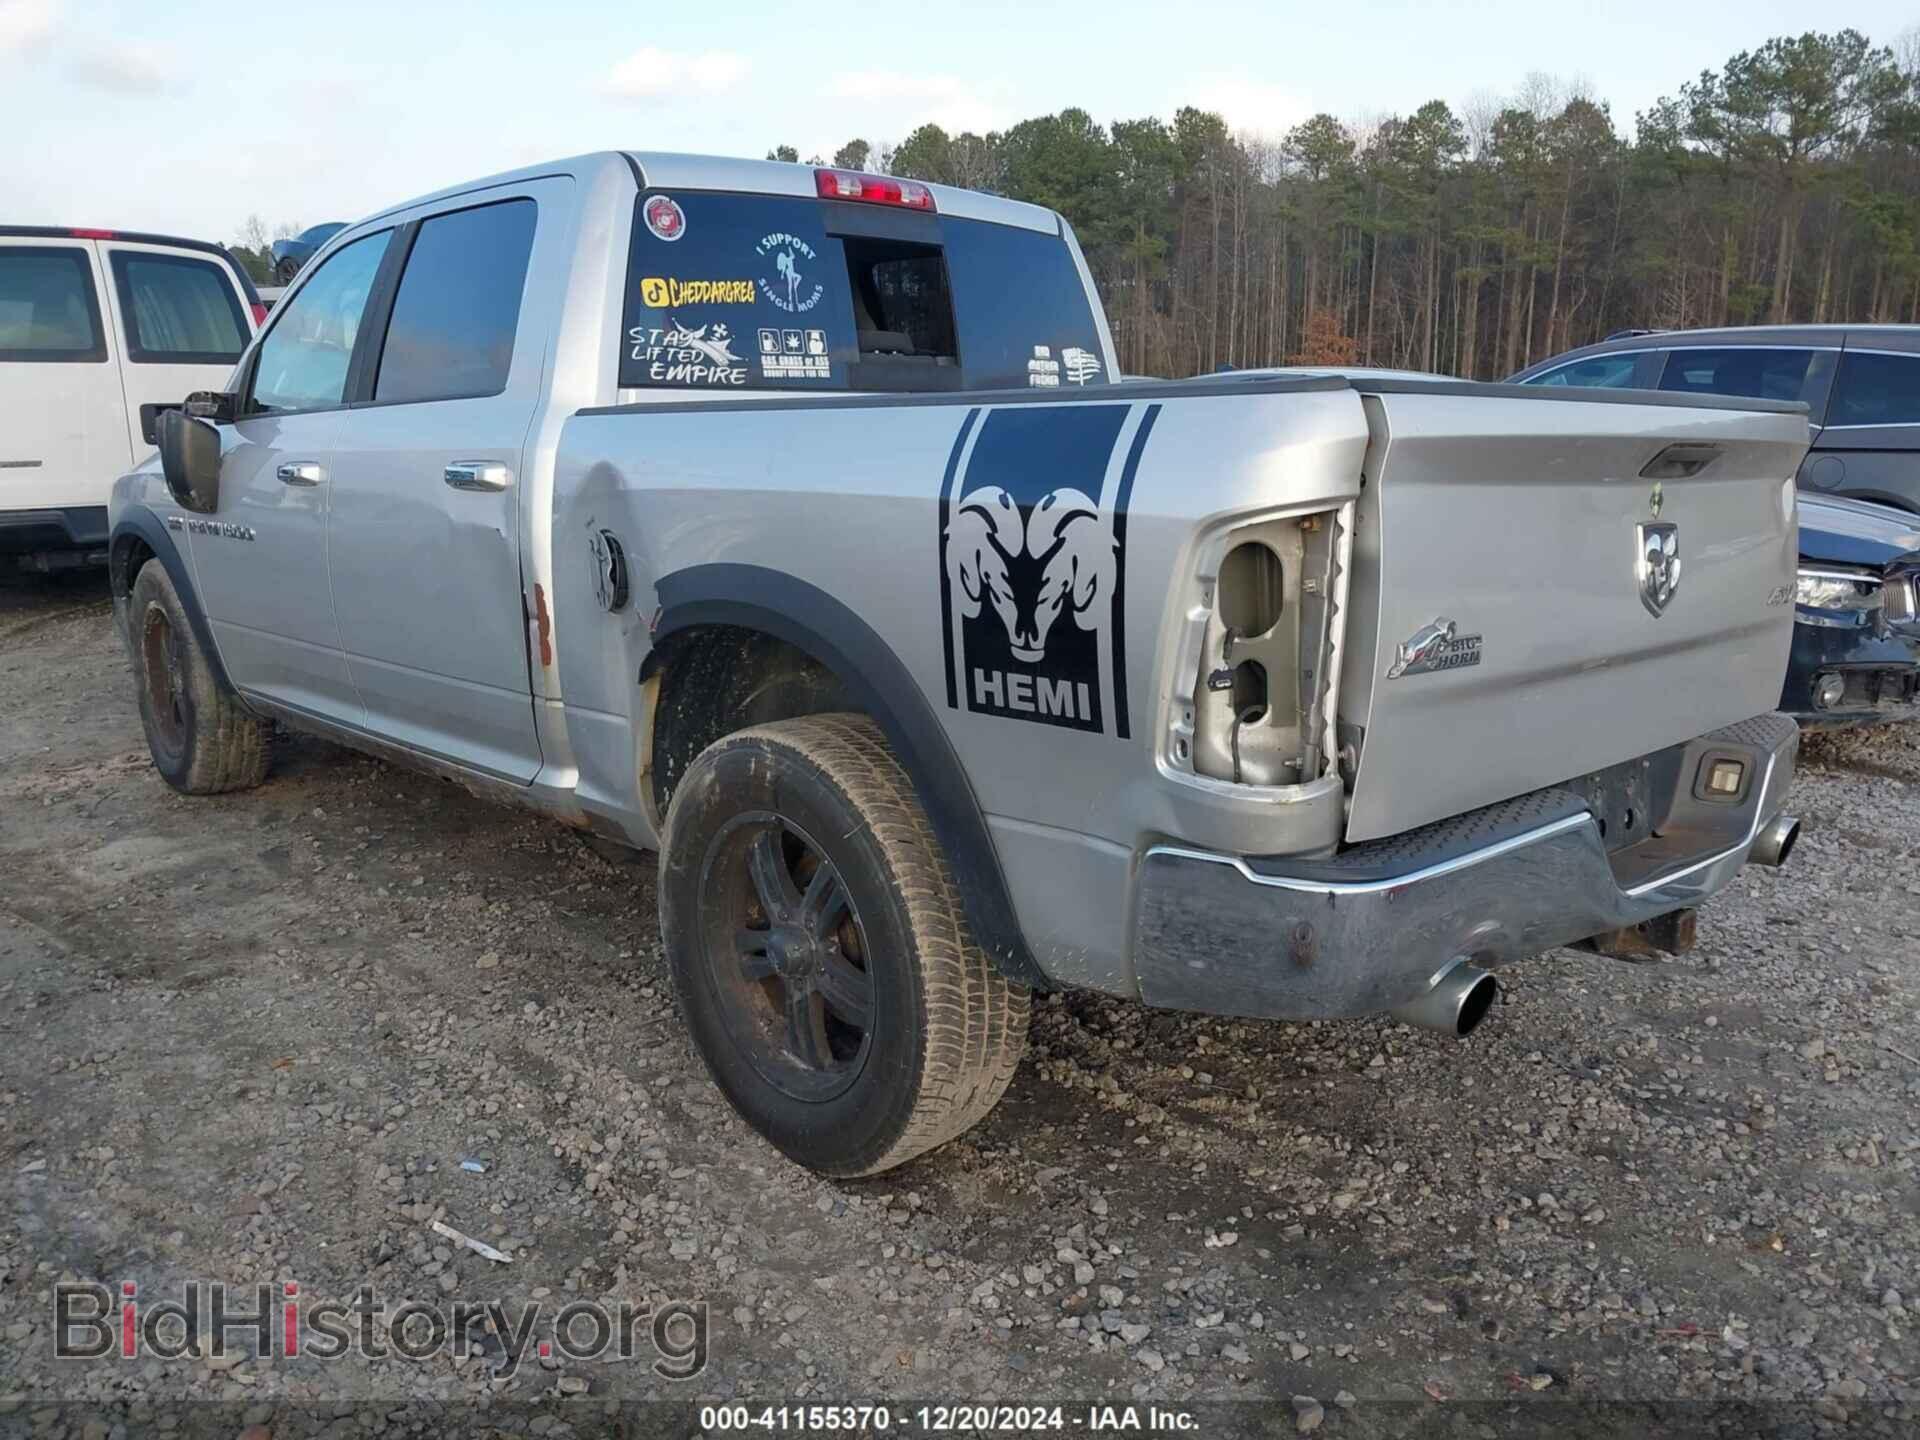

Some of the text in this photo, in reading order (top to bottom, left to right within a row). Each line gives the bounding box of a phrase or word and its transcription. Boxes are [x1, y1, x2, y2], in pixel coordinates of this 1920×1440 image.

[761, 233, 816, 259] SUPPORT
[758, 277, 824, 312] SINGLE MOMS
[631, 346, 705, 363] LIFTED
[649, 361, 748, 385] EMPIRE
[1451, 637, 1477, 652] BIG
[1440, 651, 1480, 668] HORN
[973, 667, 1092, 721] HEMI
